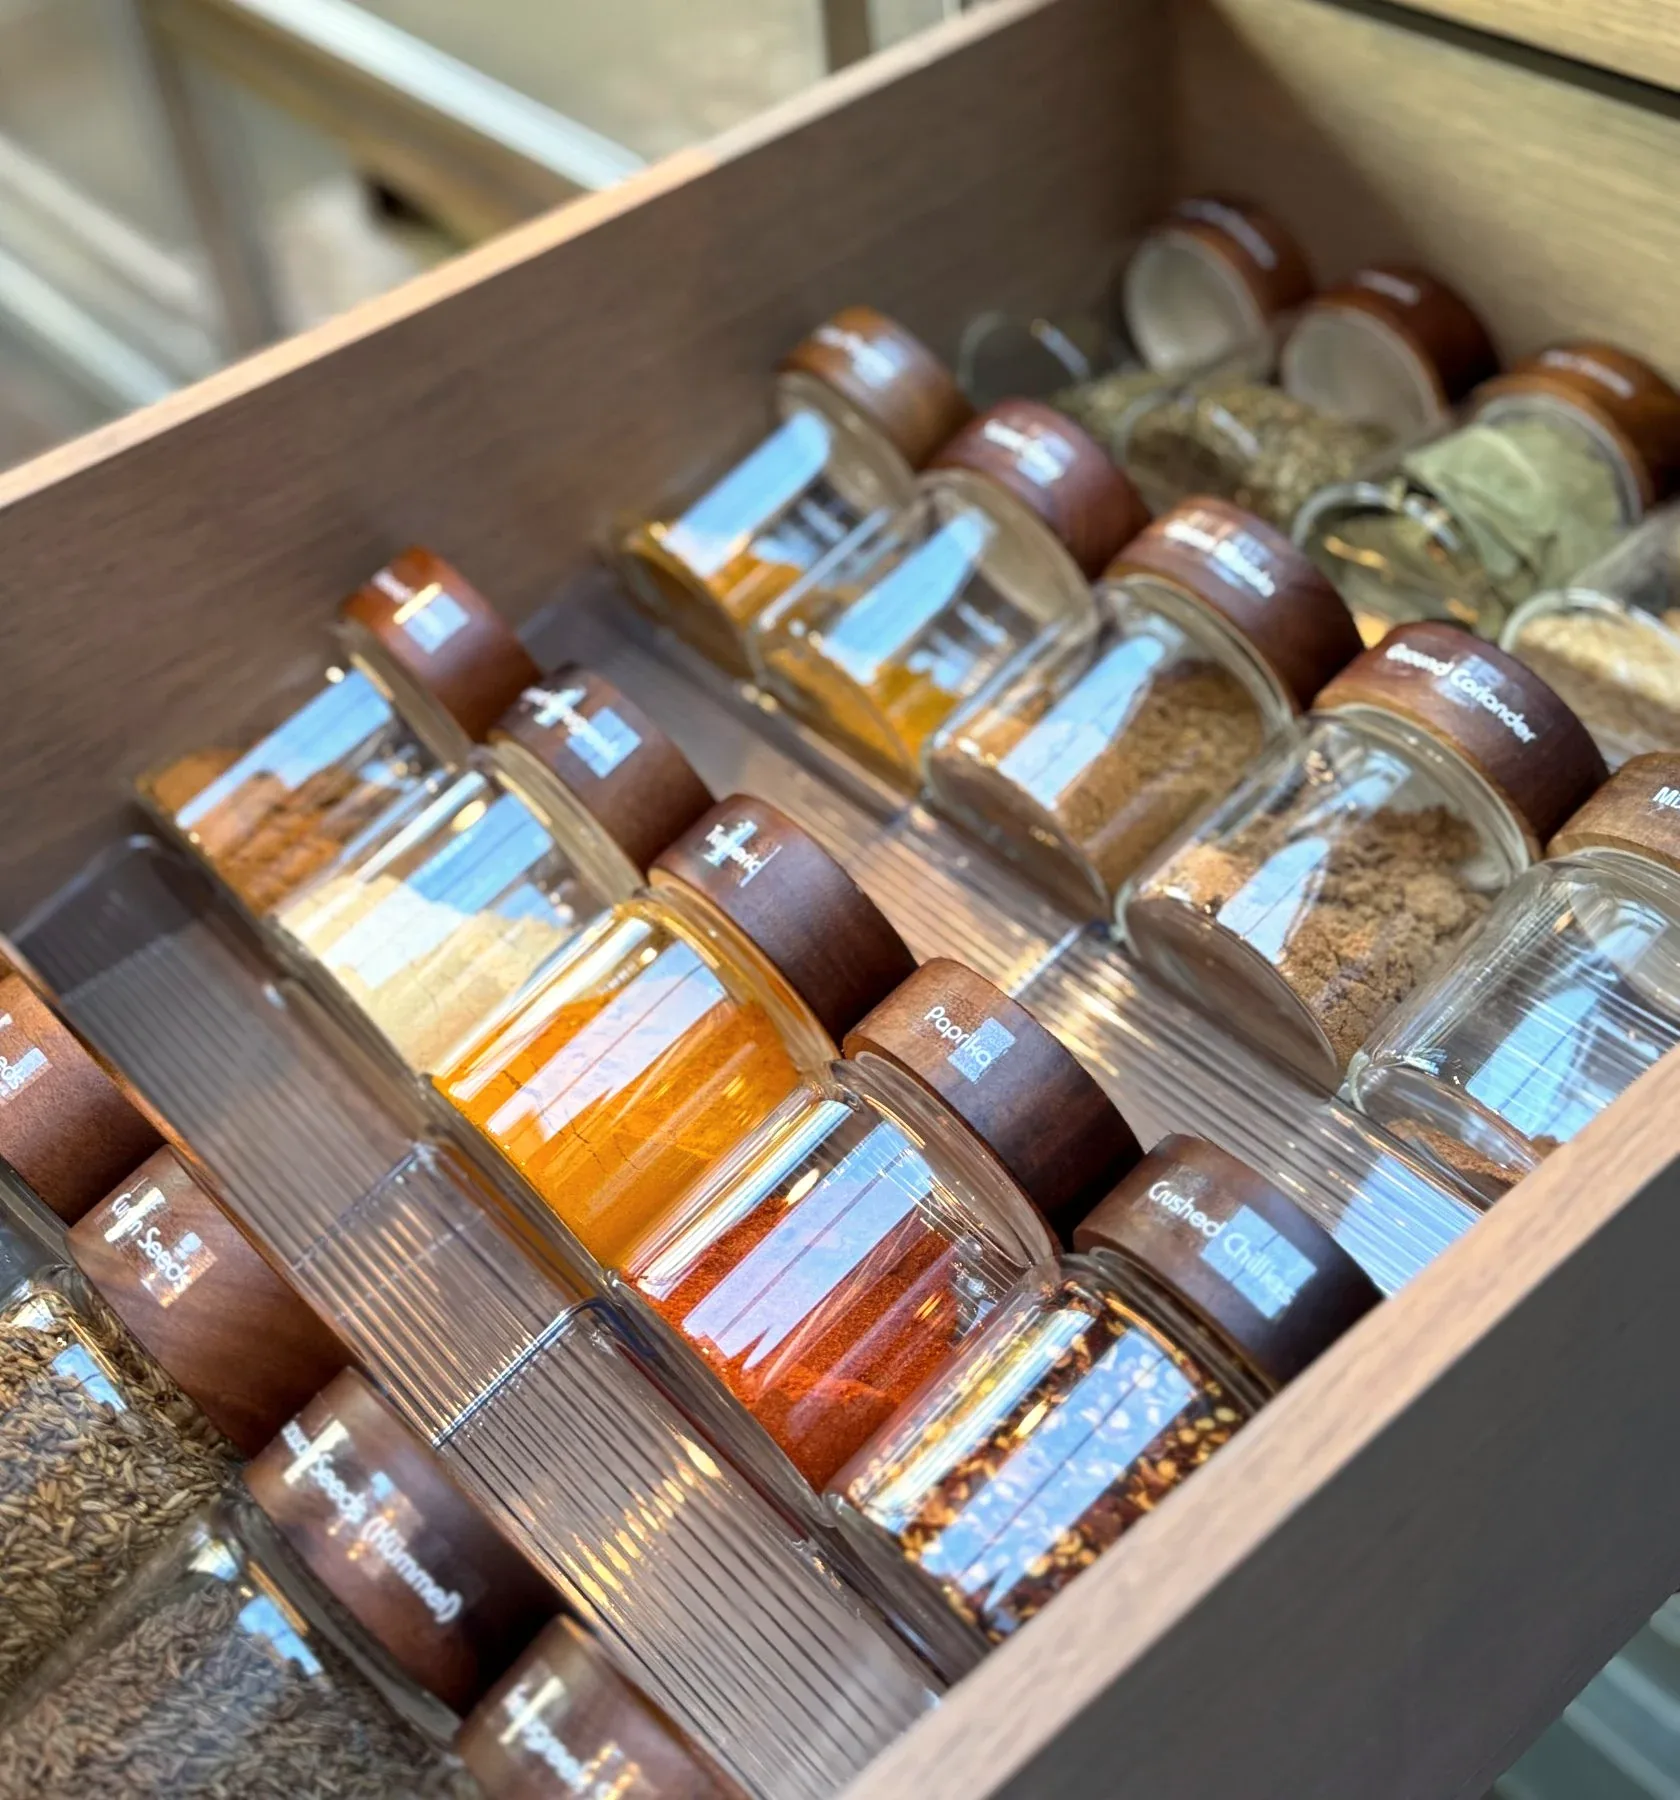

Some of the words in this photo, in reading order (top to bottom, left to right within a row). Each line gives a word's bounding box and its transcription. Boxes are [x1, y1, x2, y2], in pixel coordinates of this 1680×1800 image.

[1450, 668, 1537, 744] Coriander
[923, 1006, 992, 1067] Paprika
[137, 1226, 193, 1294] Seeds
[1149, 1180, 1228, 1238] Crushed
[1224, 1232, 1297, 1306] Chillies
[308, 1453, 367, 1525] Seeds
